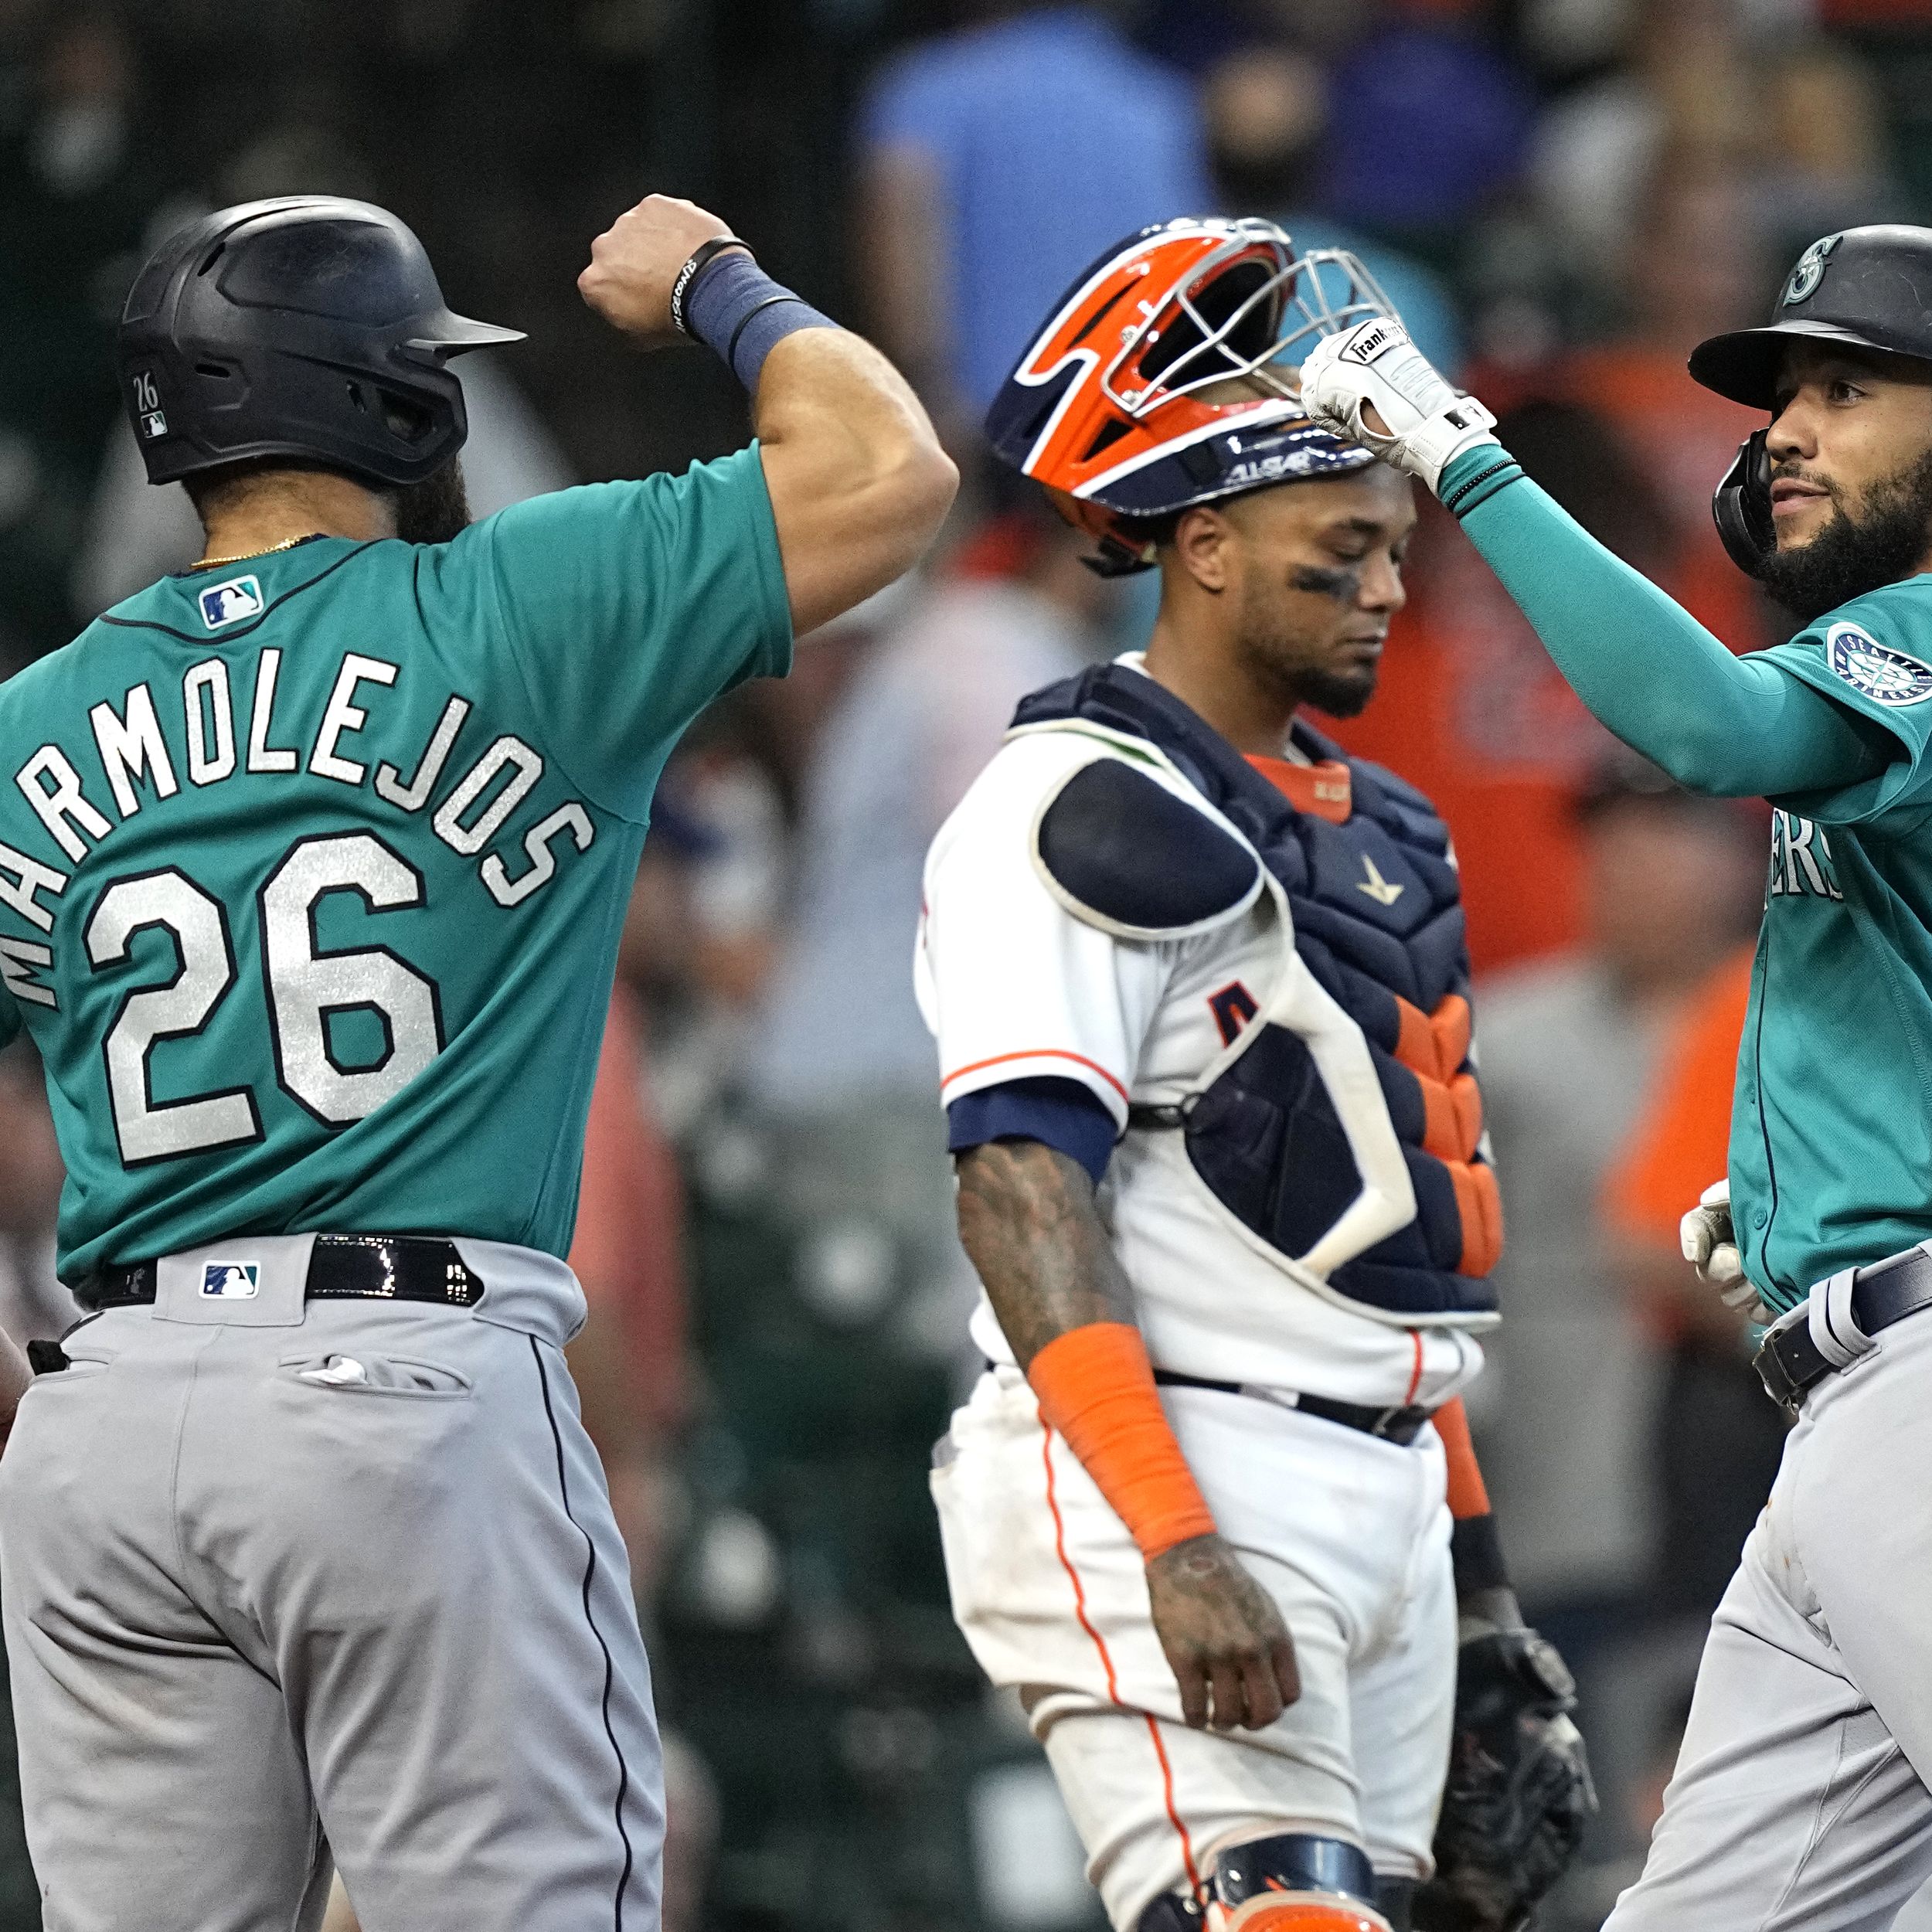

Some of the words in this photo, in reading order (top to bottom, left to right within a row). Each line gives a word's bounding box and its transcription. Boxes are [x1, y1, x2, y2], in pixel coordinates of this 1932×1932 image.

[133, 372, 158, 412] 26
[1835, 651, 1925, 699] MARINERS
[1846, 635, 1932, 680] SEATTLE
[0, 648, 595, 1012] MARMOLEJOS
[80, 827, 445, 1171] 26
